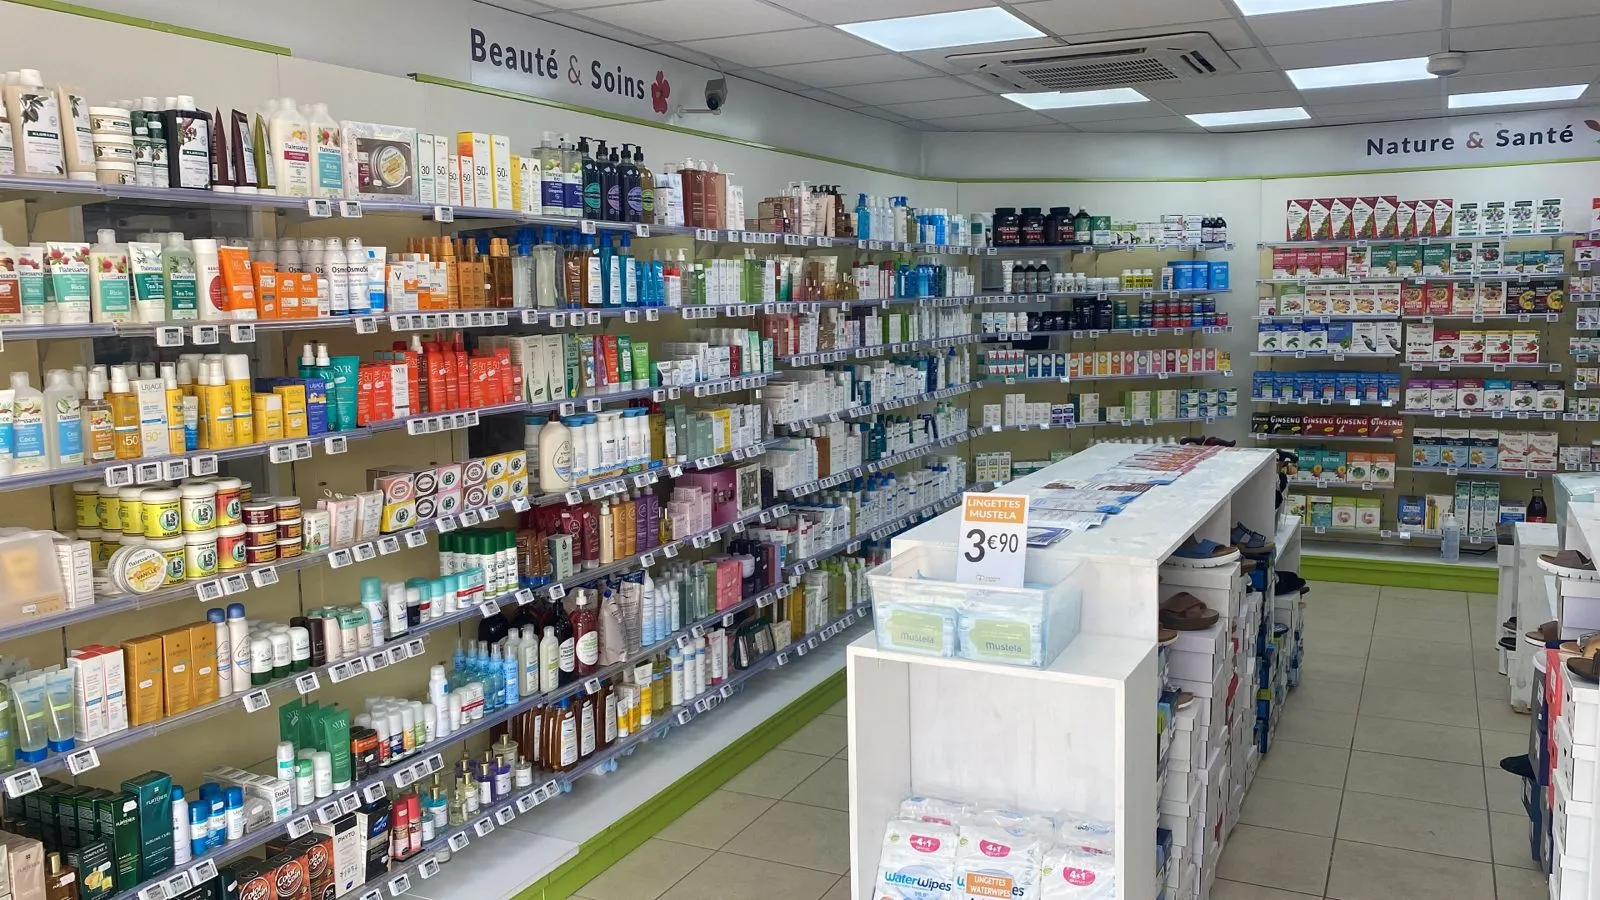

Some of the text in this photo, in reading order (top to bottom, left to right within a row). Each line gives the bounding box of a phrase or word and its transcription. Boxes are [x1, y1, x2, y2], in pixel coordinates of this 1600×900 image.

[471, 28, 644, 100] Beauté & Soins
[1366, 125, 1573, 156] Nature & Santé
[421, 165, 430, 175] 30
[333, 364, 353, 373] SVR
[1269, 416, 1301, 424] GINSENG
[1302, 416, 1334, 425] GINSENG
[1336, 417, 1367, 425] GINSENG
[1370, 417, 1403, 426] GINSENG
[967, 499, 1020, 509] LINGETTES
[969, 510, 1017, 520] MUSTELA
[337, 831, 355, 843] PHYTO
[916, 838, 932, 848] 4+1
[986, 844, 1002, 854] 4+1
[1069, 870, 1086, 881] 4+1
[974, 876, 1007, 887] LINGETTES
[970, 886, 1012, 898] WATERWIPES
